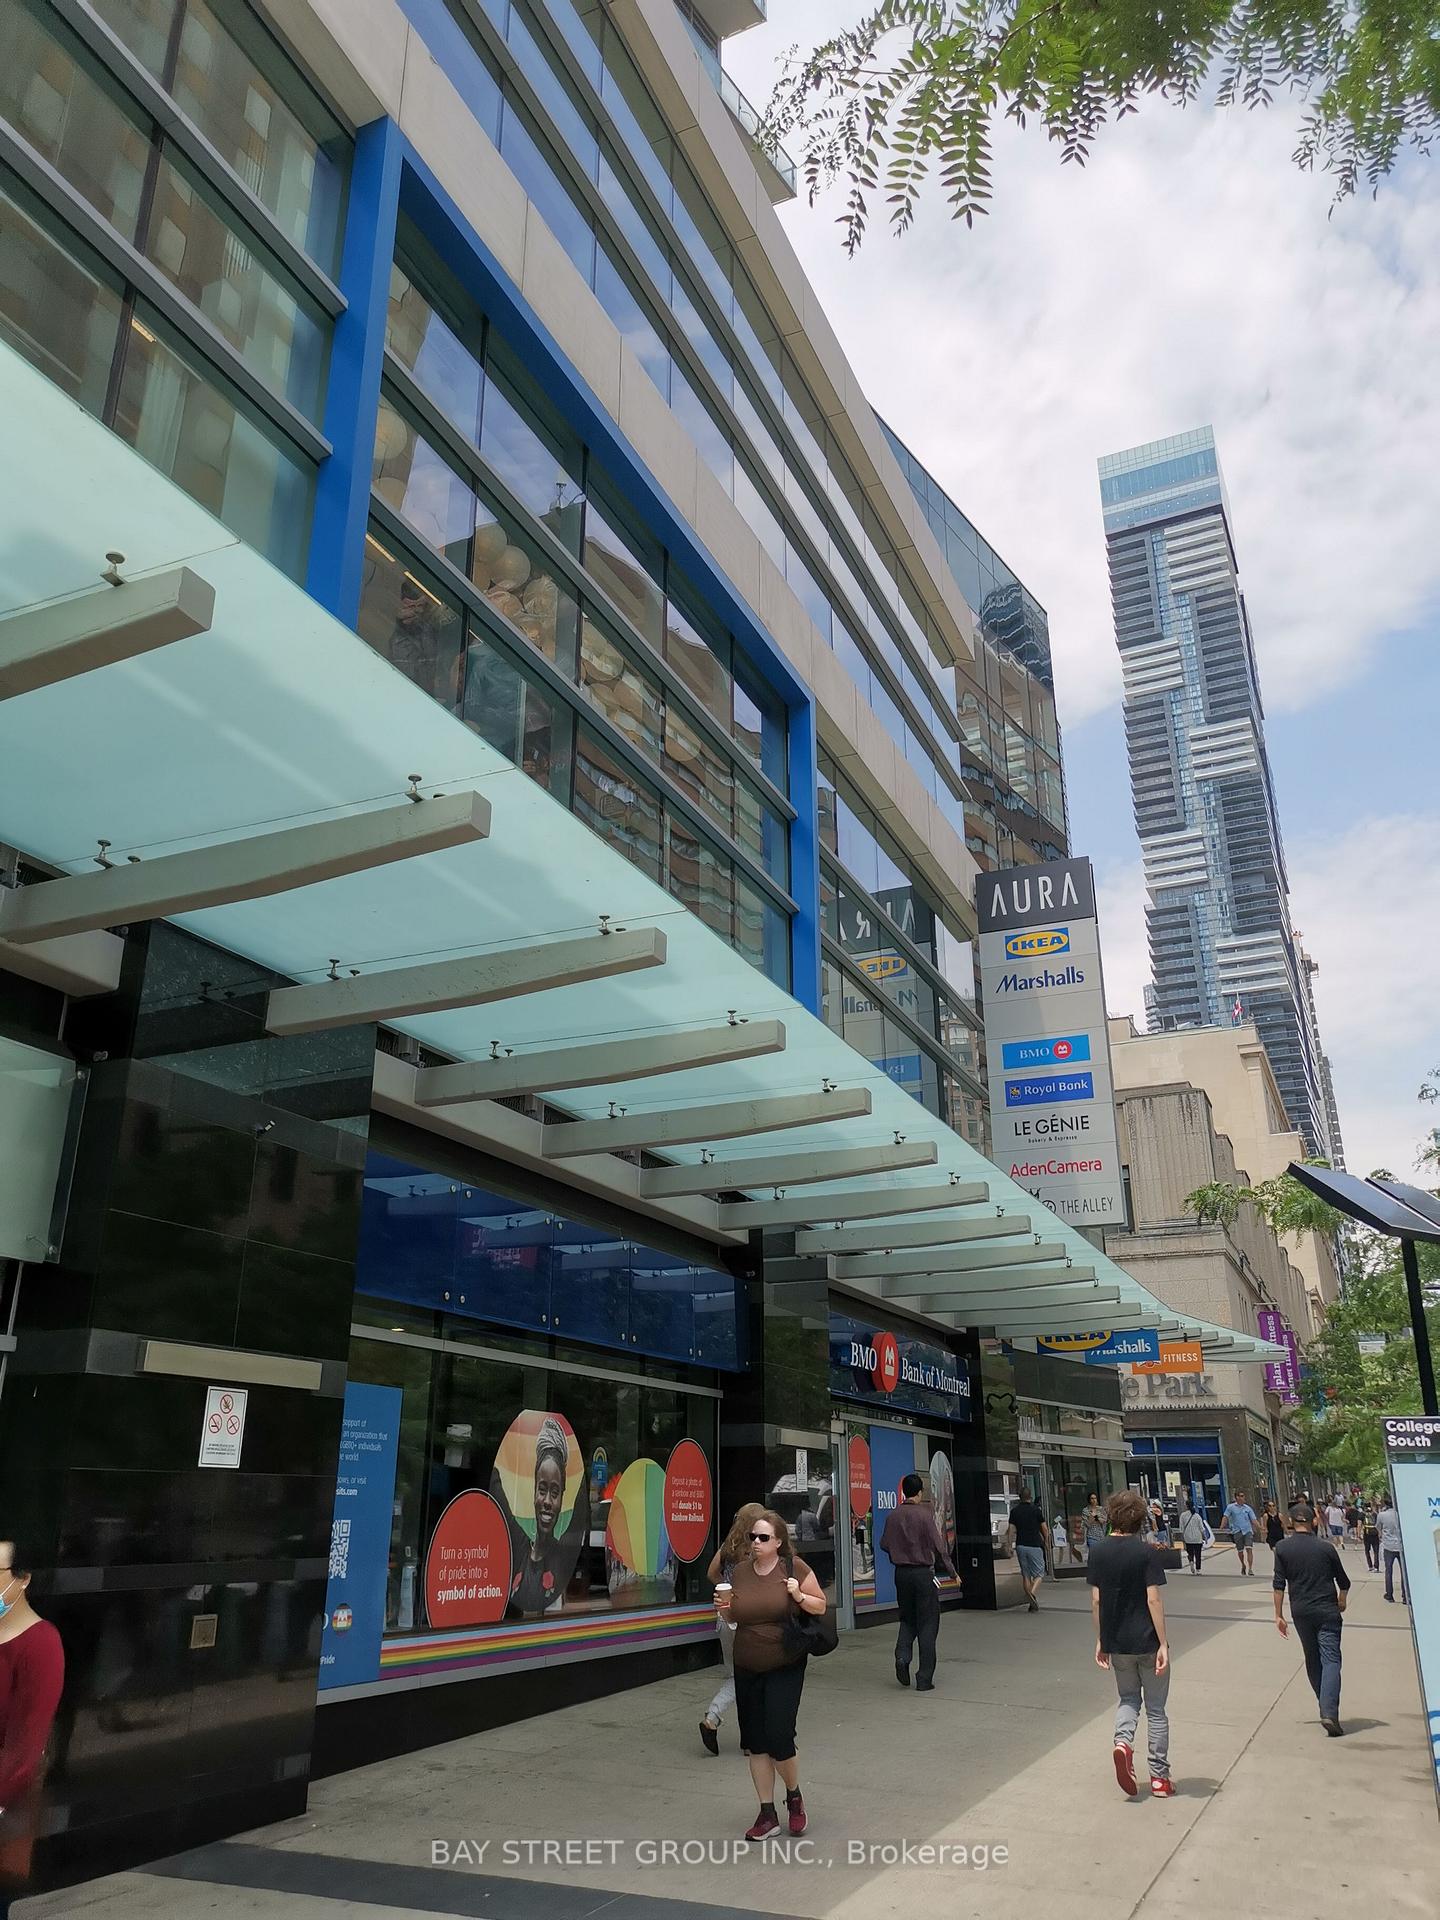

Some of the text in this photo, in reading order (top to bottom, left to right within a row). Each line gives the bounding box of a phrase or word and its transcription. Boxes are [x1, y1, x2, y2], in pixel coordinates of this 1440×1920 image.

[991, 872, 1079, 918] AURA
[1012, 935, 1064, 951] IKEA
[996, 966, 1085, 993] Marshalls
[1019, 1047, 1050, 1060] BMO
[1024, 1079, 1089, 1097] Royal Bank
[1014, 1114, 1090, 1136] LE GÉNIE
[1010, 1159, 1103, 1178] AdenCamera
[1060, 1197, 1113, 1214] THE ALLEY
[850, 1342, 877, 1372] BMO
[1163, 1352, 1198, 1363] FITNESS
[902, 1357, 971, 1398] Bank of Montreal
[1147, 1373, 1215, 1398] Park
[1385, 1420, 1440, 1435] College
[1387, 1434, 1431, 1447] South
[877, 1491, 897, 1509] BMO
[441, 1544, 489, 1562] Turn a symbol
[439, 1565, 488, 1583] of pride into a
[437, 1584, 503, 1604] symbol of action.
